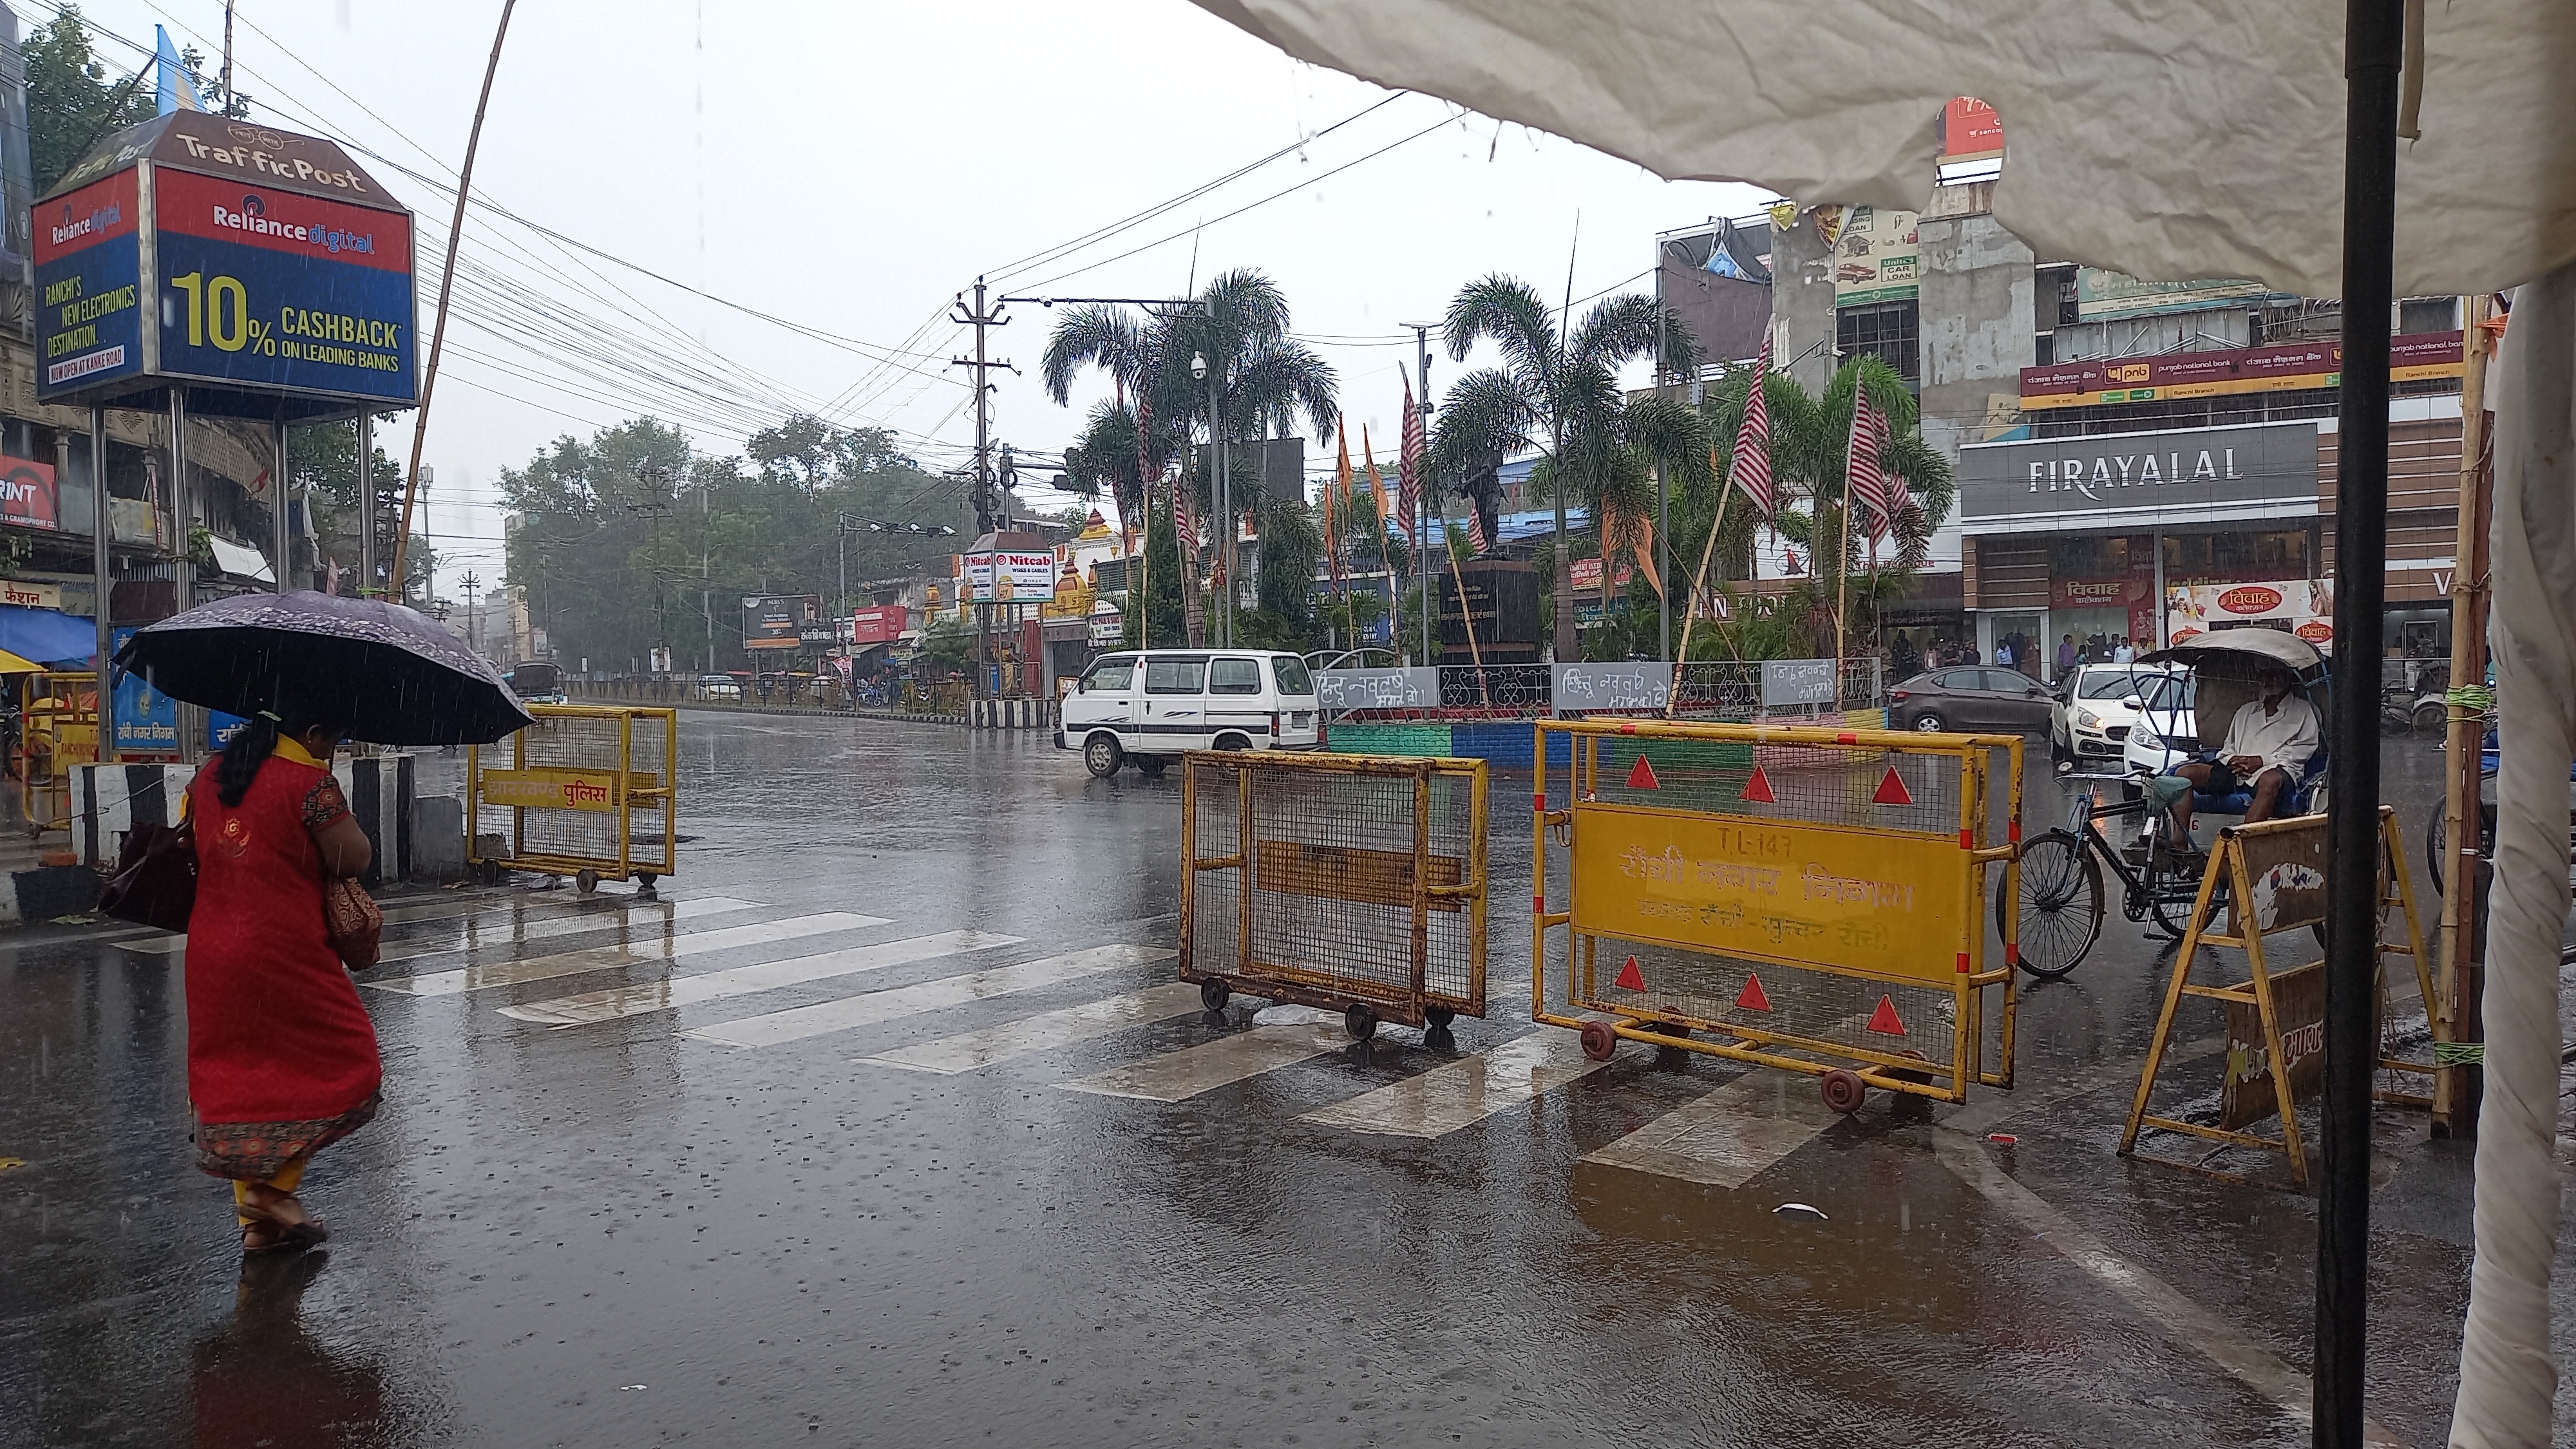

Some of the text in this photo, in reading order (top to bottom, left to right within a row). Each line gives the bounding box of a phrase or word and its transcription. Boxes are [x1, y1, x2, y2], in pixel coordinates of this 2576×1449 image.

[52, 200, 121, 246] Reliance digital
[213, 205, 375, 255] Reliance digital
[46, 275, 82, 307] RANCHI'S
[61, 284, 135, 328] NEW ELECTRONICS
[171, 272, 276, 357] 10%
[281, 341, 399, 372] ON LEADING BANKS
[2416, 341, 2447, 350] national
[51, 349, 122, 382] NOW OPEN AT KANKE ROAD
[2125, 366, 2146, 380] pnb
[2158, 363, 2182, 373] punjab
[2183, 361, 2212, 369] national
[2029, 447, 2244, 502] FIRAYALAL
[10, 515, 47, 527] GRAMOPHONE
[971, 556, 991, 567] Nitcab
[1009, 555, 1051, 565] Nitcab
[4, 582, 40, 605] फैशन
[2066, 581, 2122, 596] विवाह
[2229, 590, 2270, 605] विवाह
[2302, 626, 2327, 637] विवाह
[118, 722, 132, 740] रांची
[133, 726, 151, 741] नगर
[152, 721, 175, 741] निगम
[563, 779, 608, 807] पुलिस
[1696, 860, 1782, 896] नगर
[1801, 862, 1915, 913] निगम
